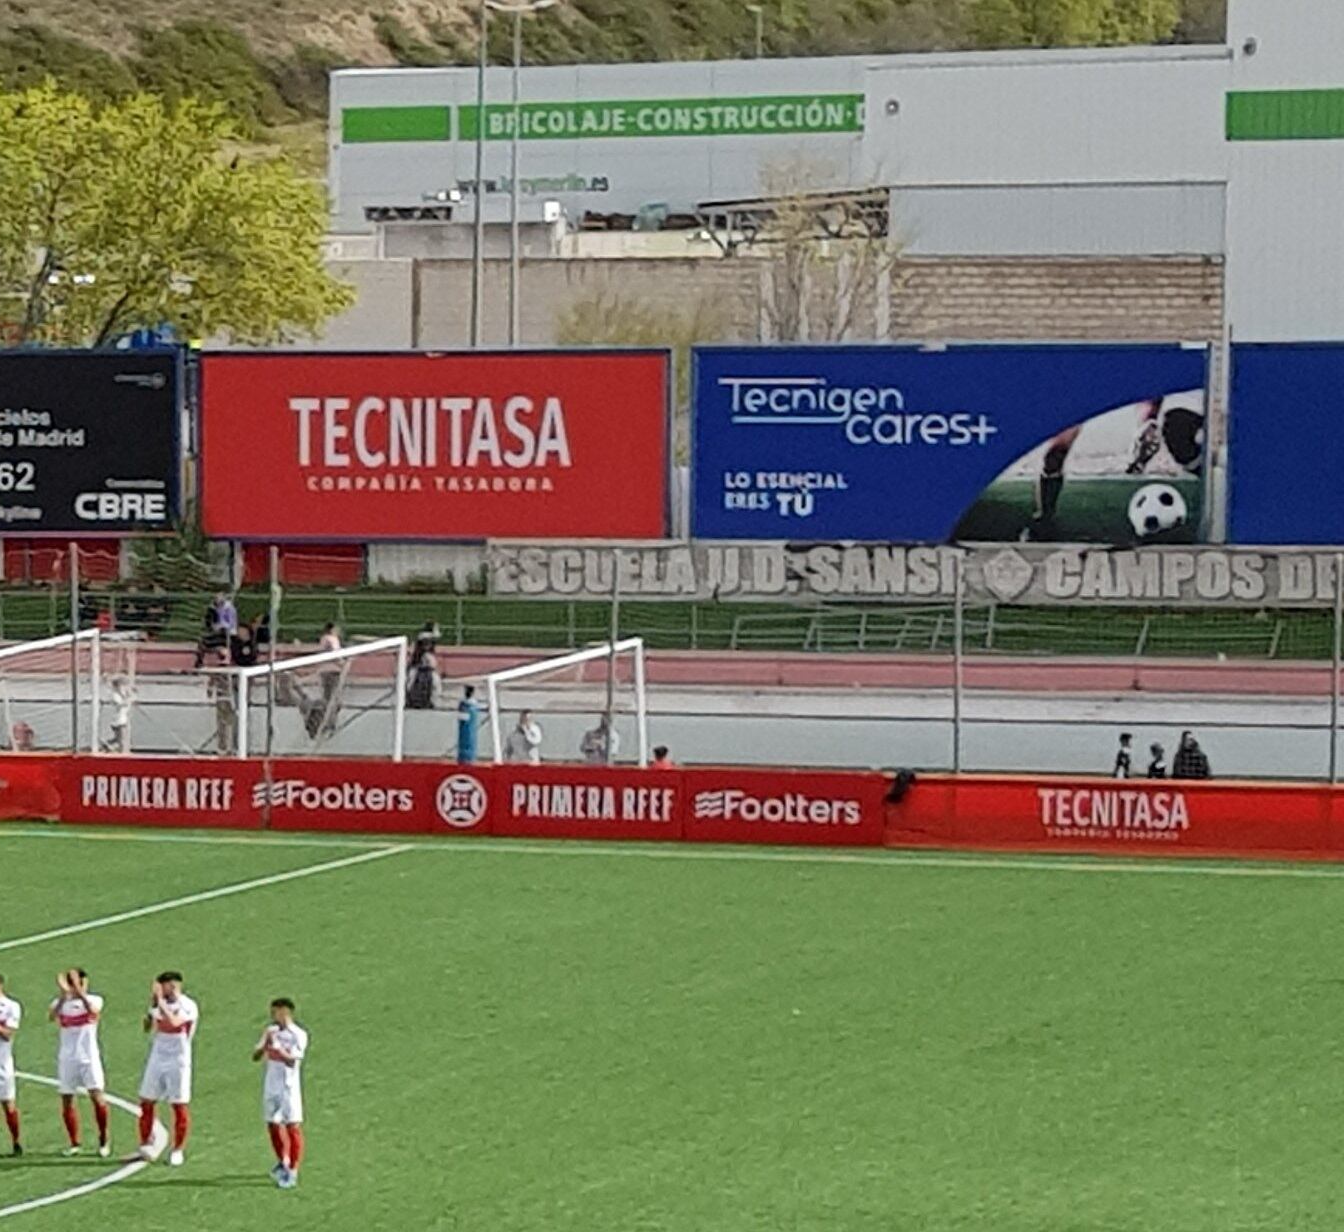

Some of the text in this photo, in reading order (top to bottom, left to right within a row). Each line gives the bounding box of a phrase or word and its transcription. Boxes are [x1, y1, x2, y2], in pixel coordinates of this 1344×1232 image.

[718, 377, 904, 424] Tecnigen
[17, 428, 86, 447] Madrid
[289, 396, 572, 468] TECNITASA
[724, 471, 751, 489] LO
[73, 492, 167, 521] CBRE
[1045, 549, 1266, 599] CAMPOS
[81, 774, 180, 810] PRIMERA
[285, 780, 413, 812] Footters
[511, 783, 614, 820] PRIMERA
[723, 790, 862, 825] Footters
[1036, 788, 1190, 831] TECNITASA
